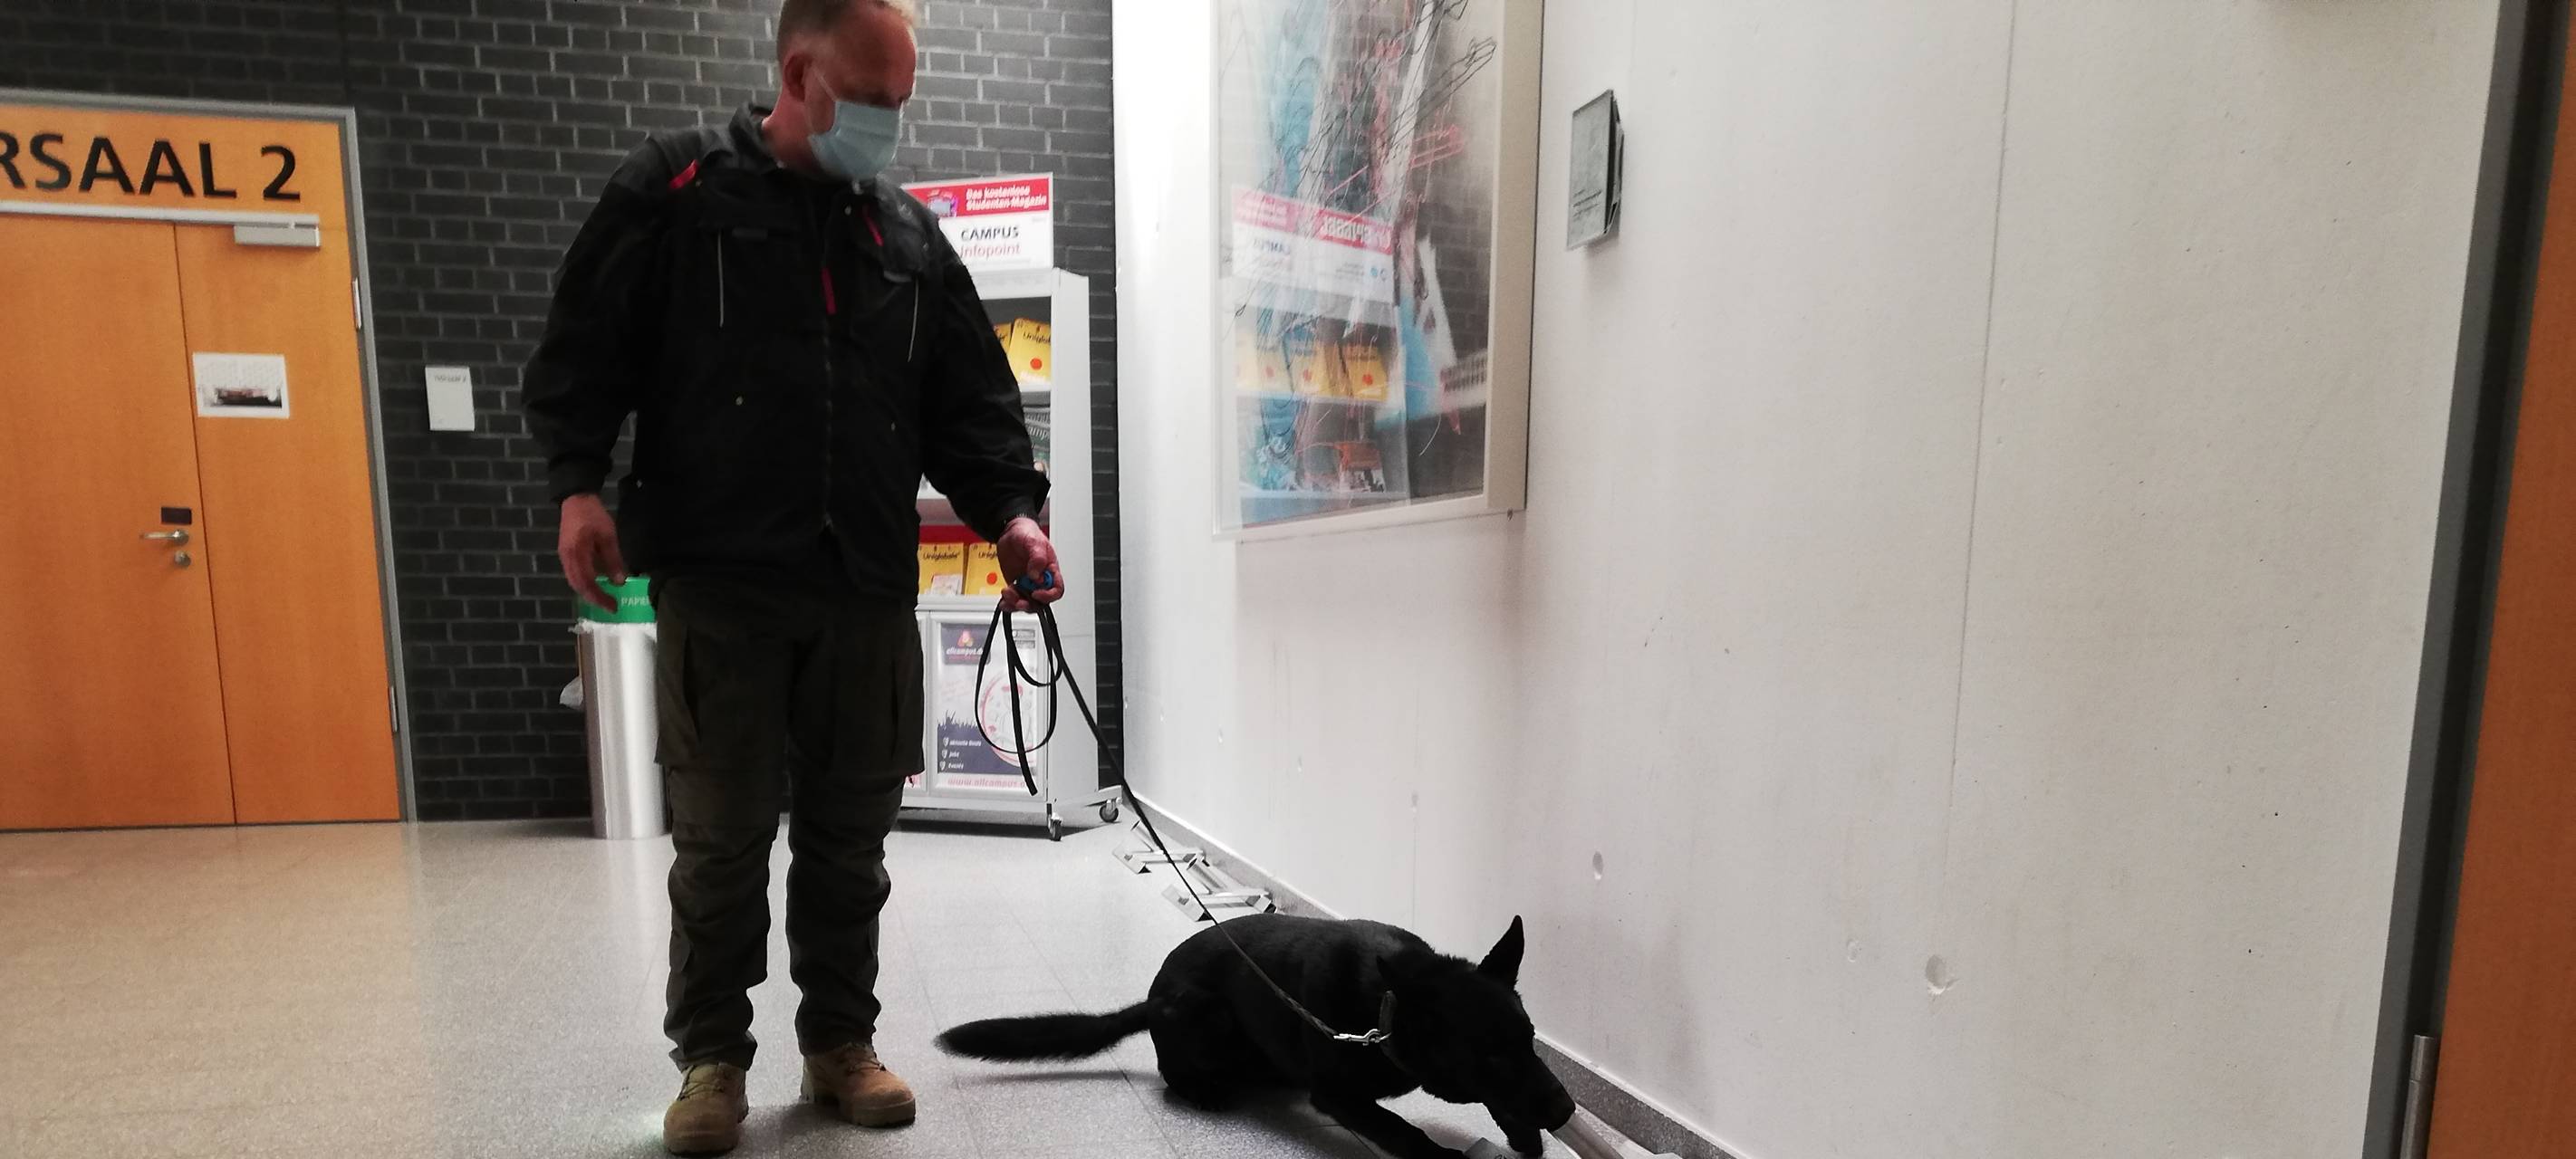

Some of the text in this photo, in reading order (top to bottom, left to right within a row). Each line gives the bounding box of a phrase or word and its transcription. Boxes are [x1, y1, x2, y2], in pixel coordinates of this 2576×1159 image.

[0, 131, 301, 201] RSAAL 2
[984, 184, 1031, 199] kostenlose
[966, 194, 1047, 211] Studenten-Magazin
[960, 225, 1020, 242] CAMPUS
[960, 242, 1022, 259] Infopoint
